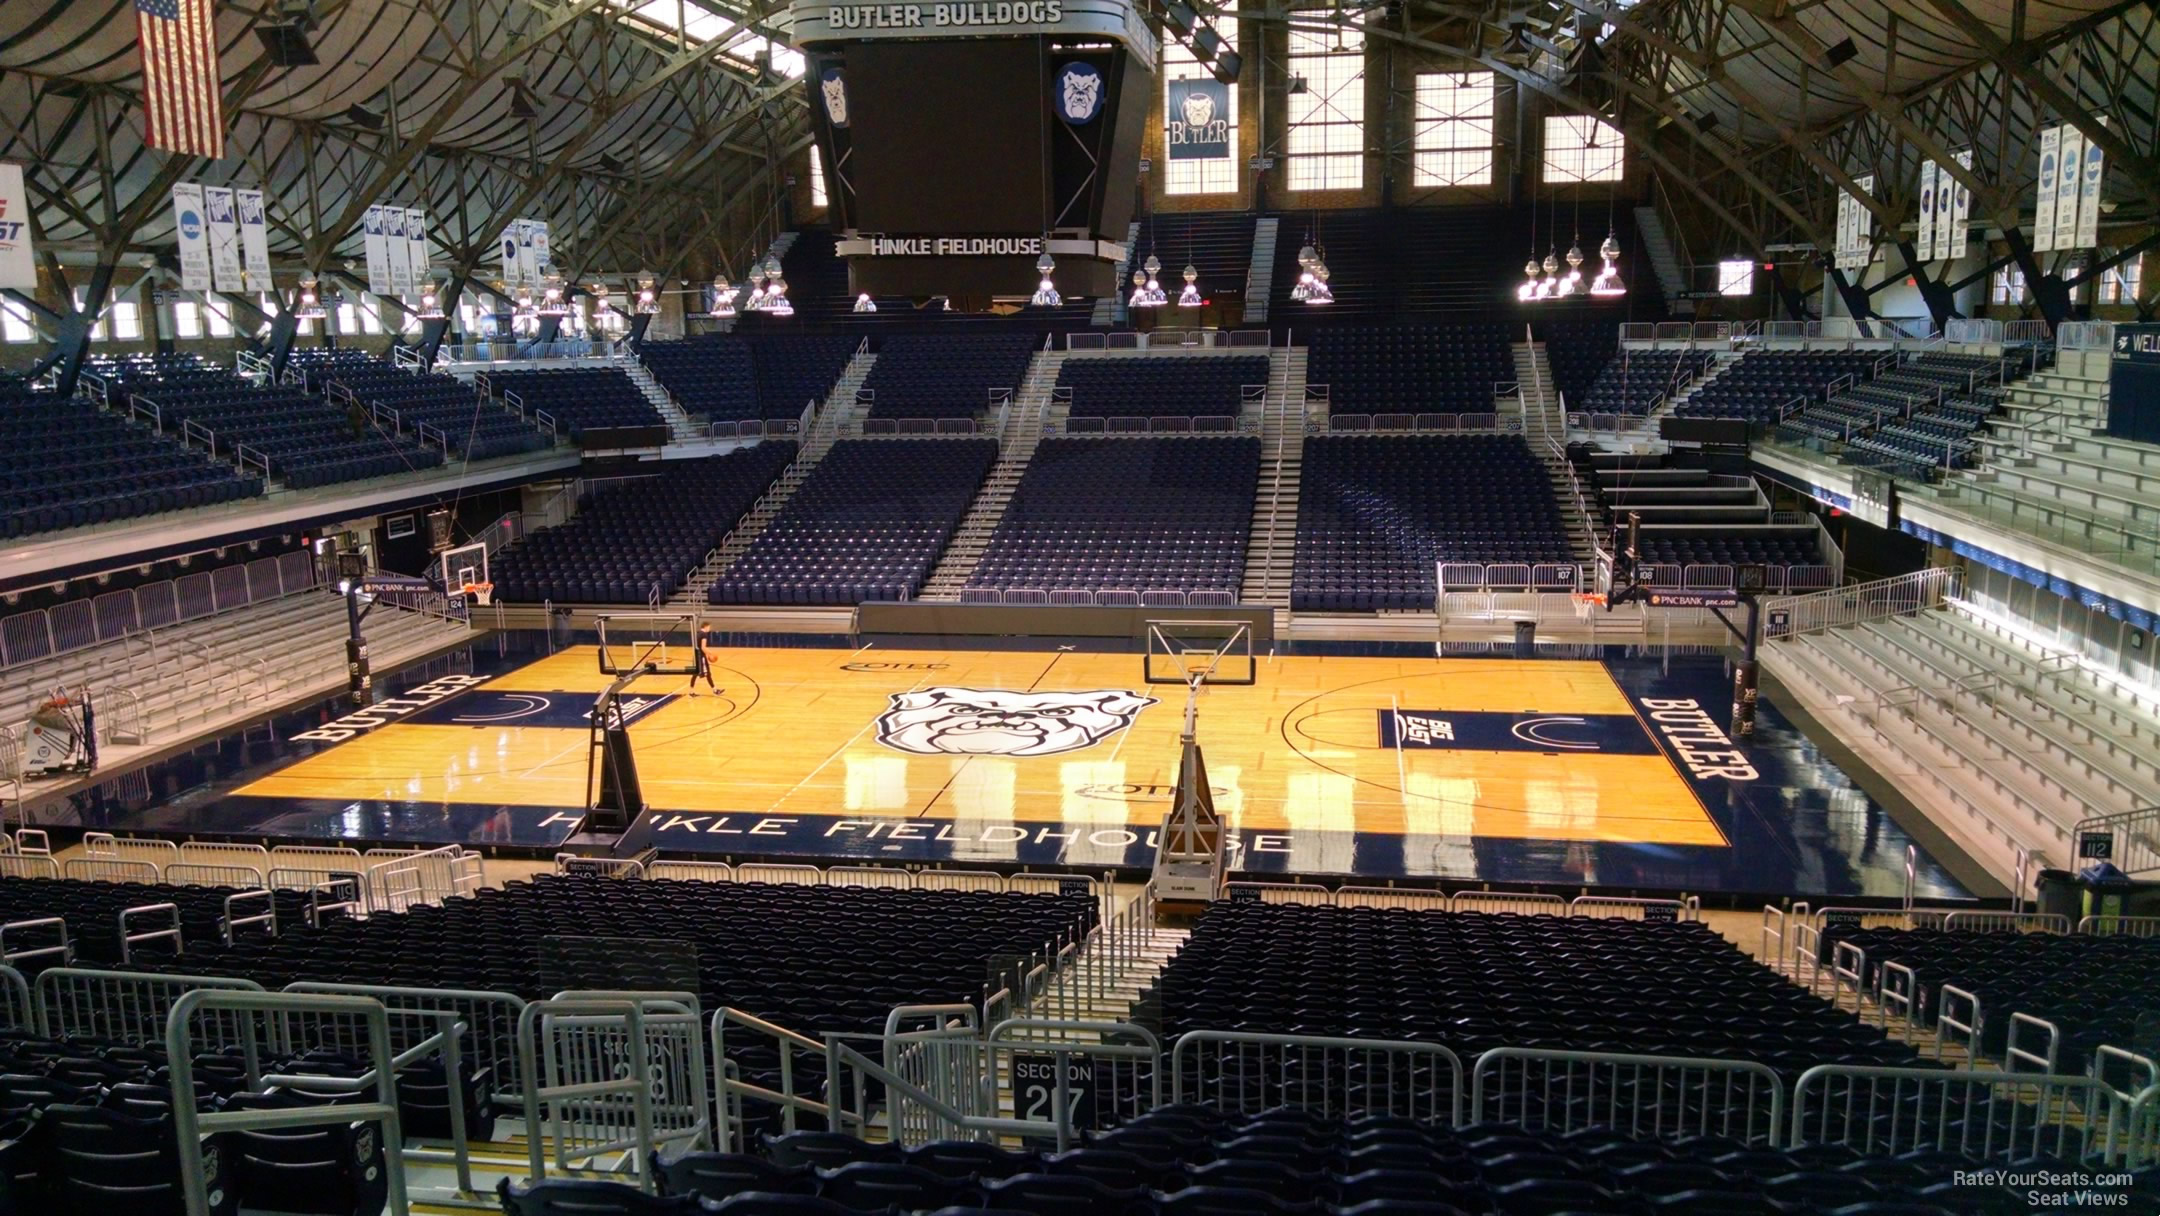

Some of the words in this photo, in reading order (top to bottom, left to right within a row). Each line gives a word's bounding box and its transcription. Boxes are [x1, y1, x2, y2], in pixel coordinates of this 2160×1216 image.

[829, 5, 922, 29] BUTLER
[934, 1, 1063, 26] BULLDOGS
[1171, 119, 1228, 145] BUTLER
[871, 238, 931, 256] HINKLE
[938, 238, 1041, 256] FIELDHOUSE
[1557, 571, 1571, 580] 107
[1639, 571, 1653, 580] 108
[1705, 598, 1736, 607] pnc.com
[289, 674, 493, 743] BUTLER
[1406, 715, 1431, 745] EAST
[1428, 719, 1455, 740] BIG
[1640, 698, 1760, 780] BUTLER
[2086, 843, 2107, 857] 112
[1231, 888, 1260, 896] SECTION
[1646, 906, 1677, 914] SECTION
[1828, 914, 1861, 922] SECTION
